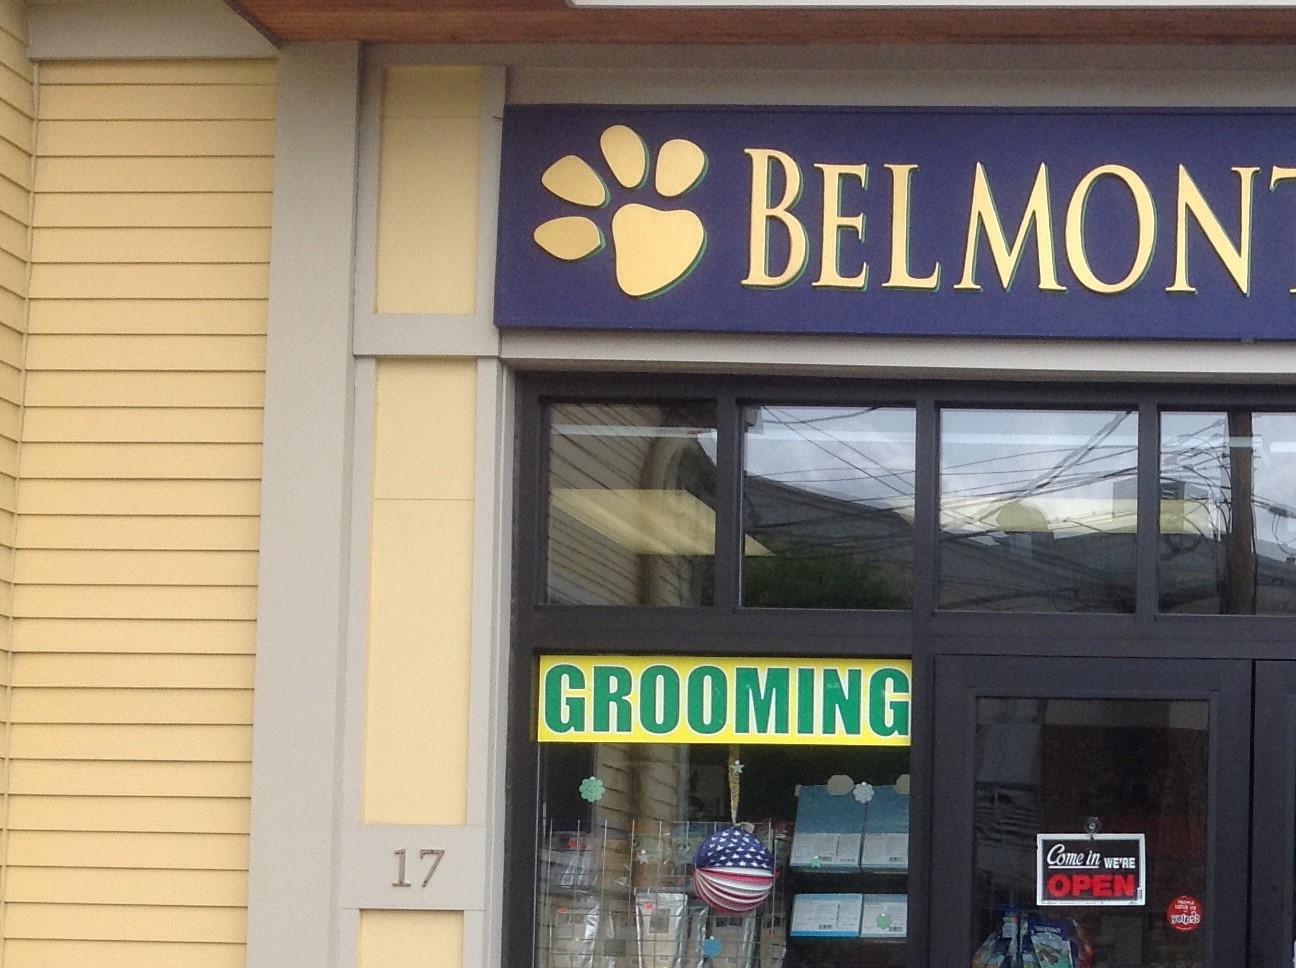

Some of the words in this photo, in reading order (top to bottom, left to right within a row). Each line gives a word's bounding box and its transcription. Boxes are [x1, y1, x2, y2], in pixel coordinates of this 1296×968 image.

[544, 663, 910, 738] GROOMING
[392, 848, 446, 888] 17
[1046, 843, 1085, 867] Come
[1086, 849, 1101, 866] in
[1103, 856, 1136, 870] WE'RE
[1046, 873, 1136, 898] OPEN
[1171, 914, 1191, 925] yelp
